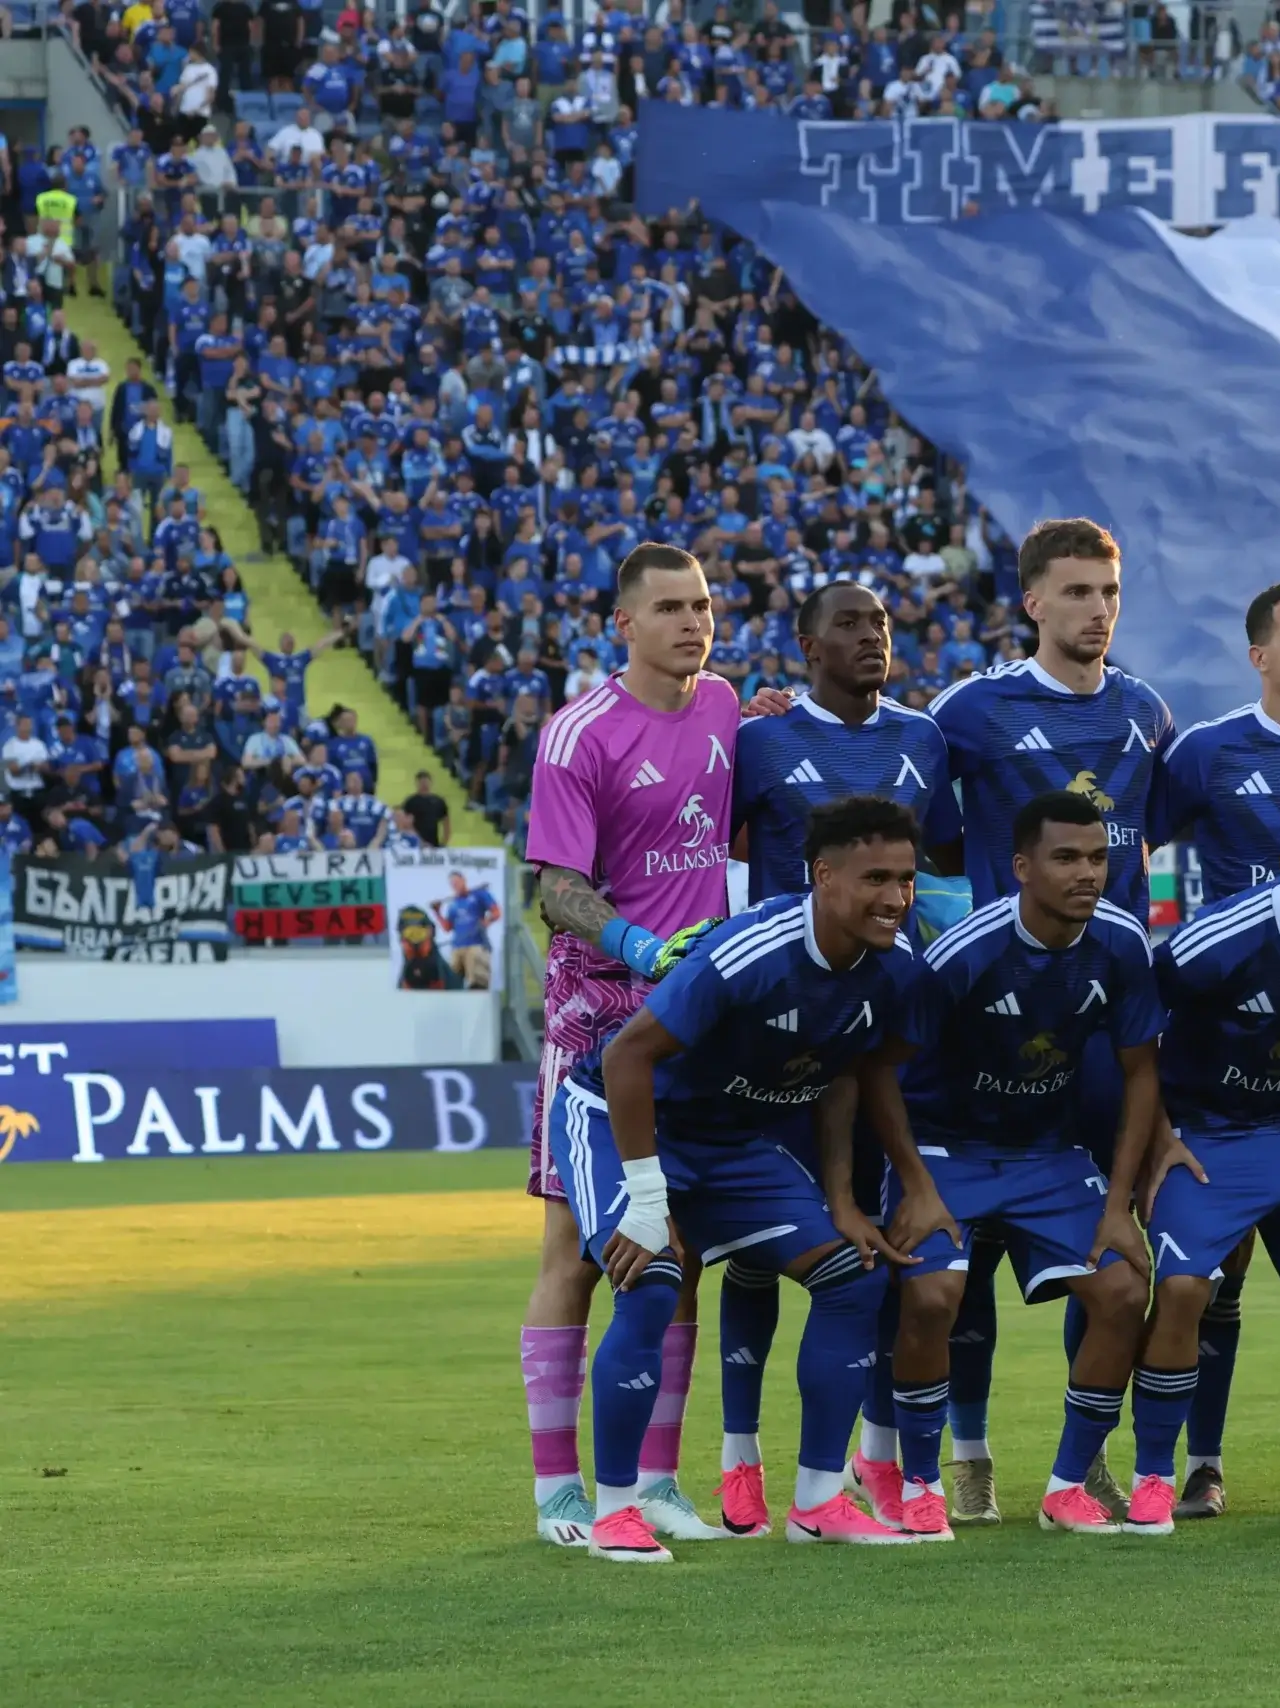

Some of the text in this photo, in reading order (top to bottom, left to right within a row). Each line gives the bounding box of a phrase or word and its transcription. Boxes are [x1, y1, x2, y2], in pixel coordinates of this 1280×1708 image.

[798, 116, 1174, 223] TIME
[1106, 822, 1138, 847] BET
[236, 852, 373, 880] ULTRA
[644, 850, 708, 877] PALMS
[236, 879, 376, 908] LEVSKI
[241, 907, 377, 936] HISAR
[723, 1074, 829, 1104] PALMS BET
[973, 1071, 1049, 1095] PALMS
[62, 1072, 394, 1162] PALMS
